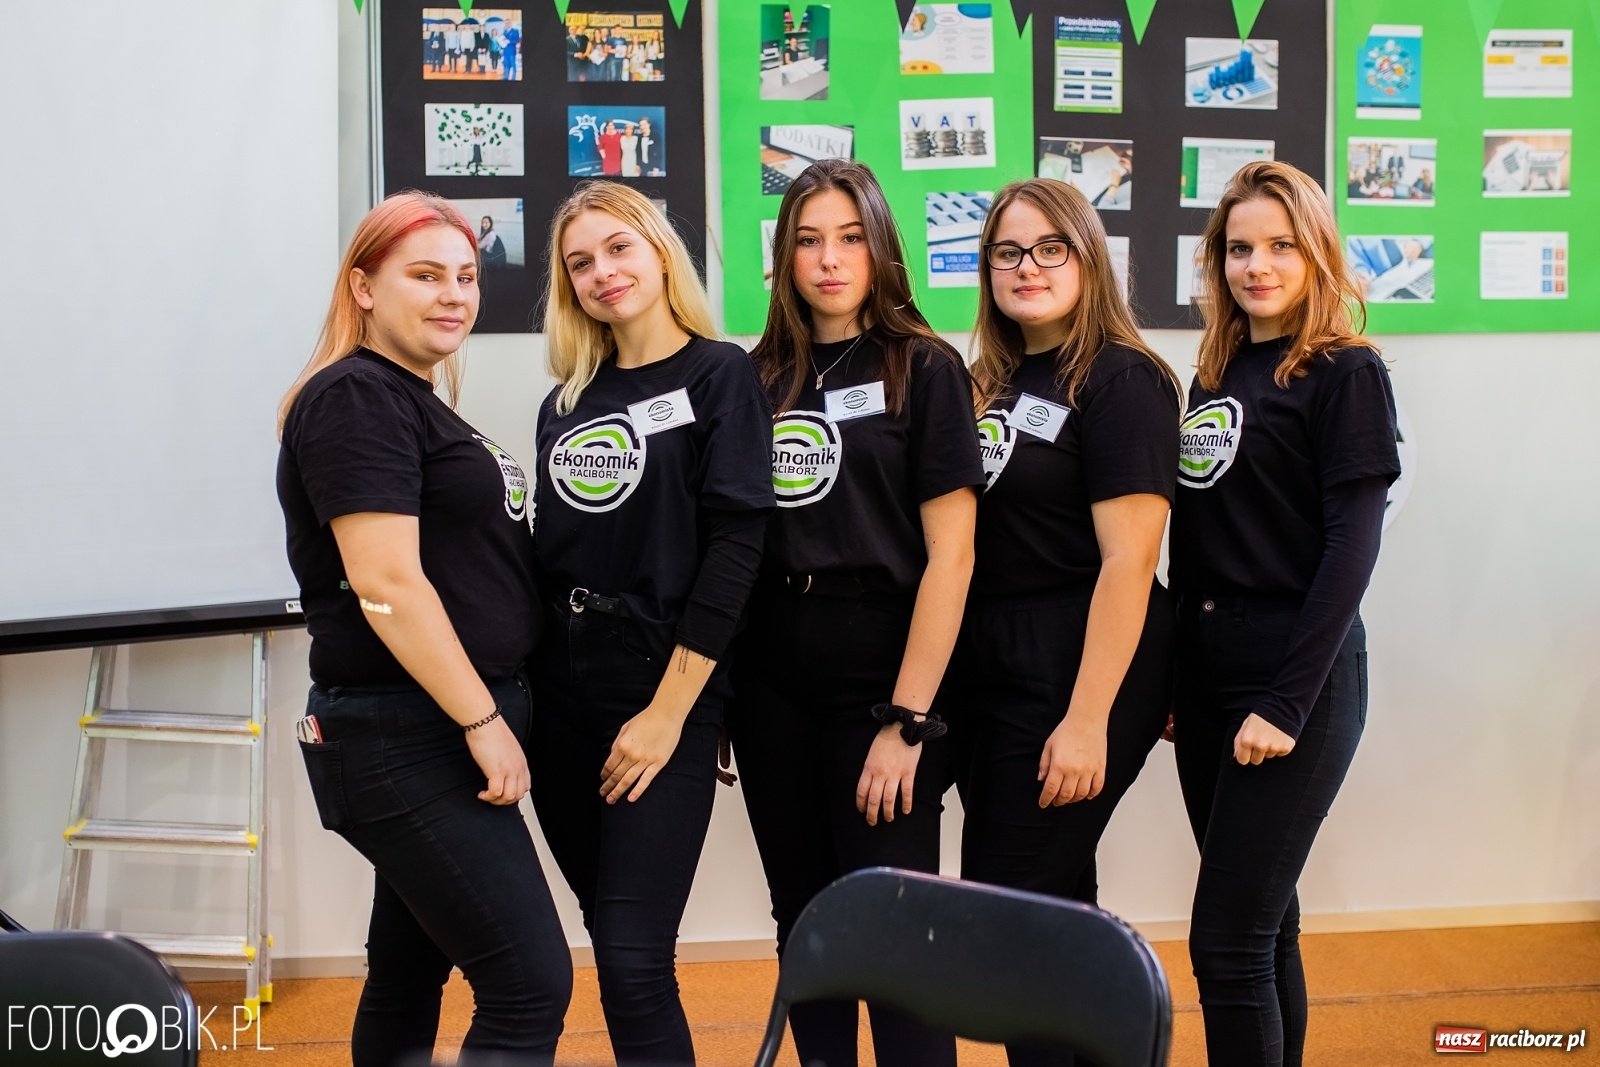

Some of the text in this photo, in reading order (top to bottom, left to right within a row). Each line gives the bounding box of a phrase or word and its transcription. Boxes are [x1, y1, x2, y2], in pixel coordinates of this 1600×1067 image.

[911, 115, 976, 128] VAT
[775, 126, 844, 159] PODATKI
[553, 449, 640, 471] ekonomik
[569, 468, 619, 480] RACIBÓRZ
